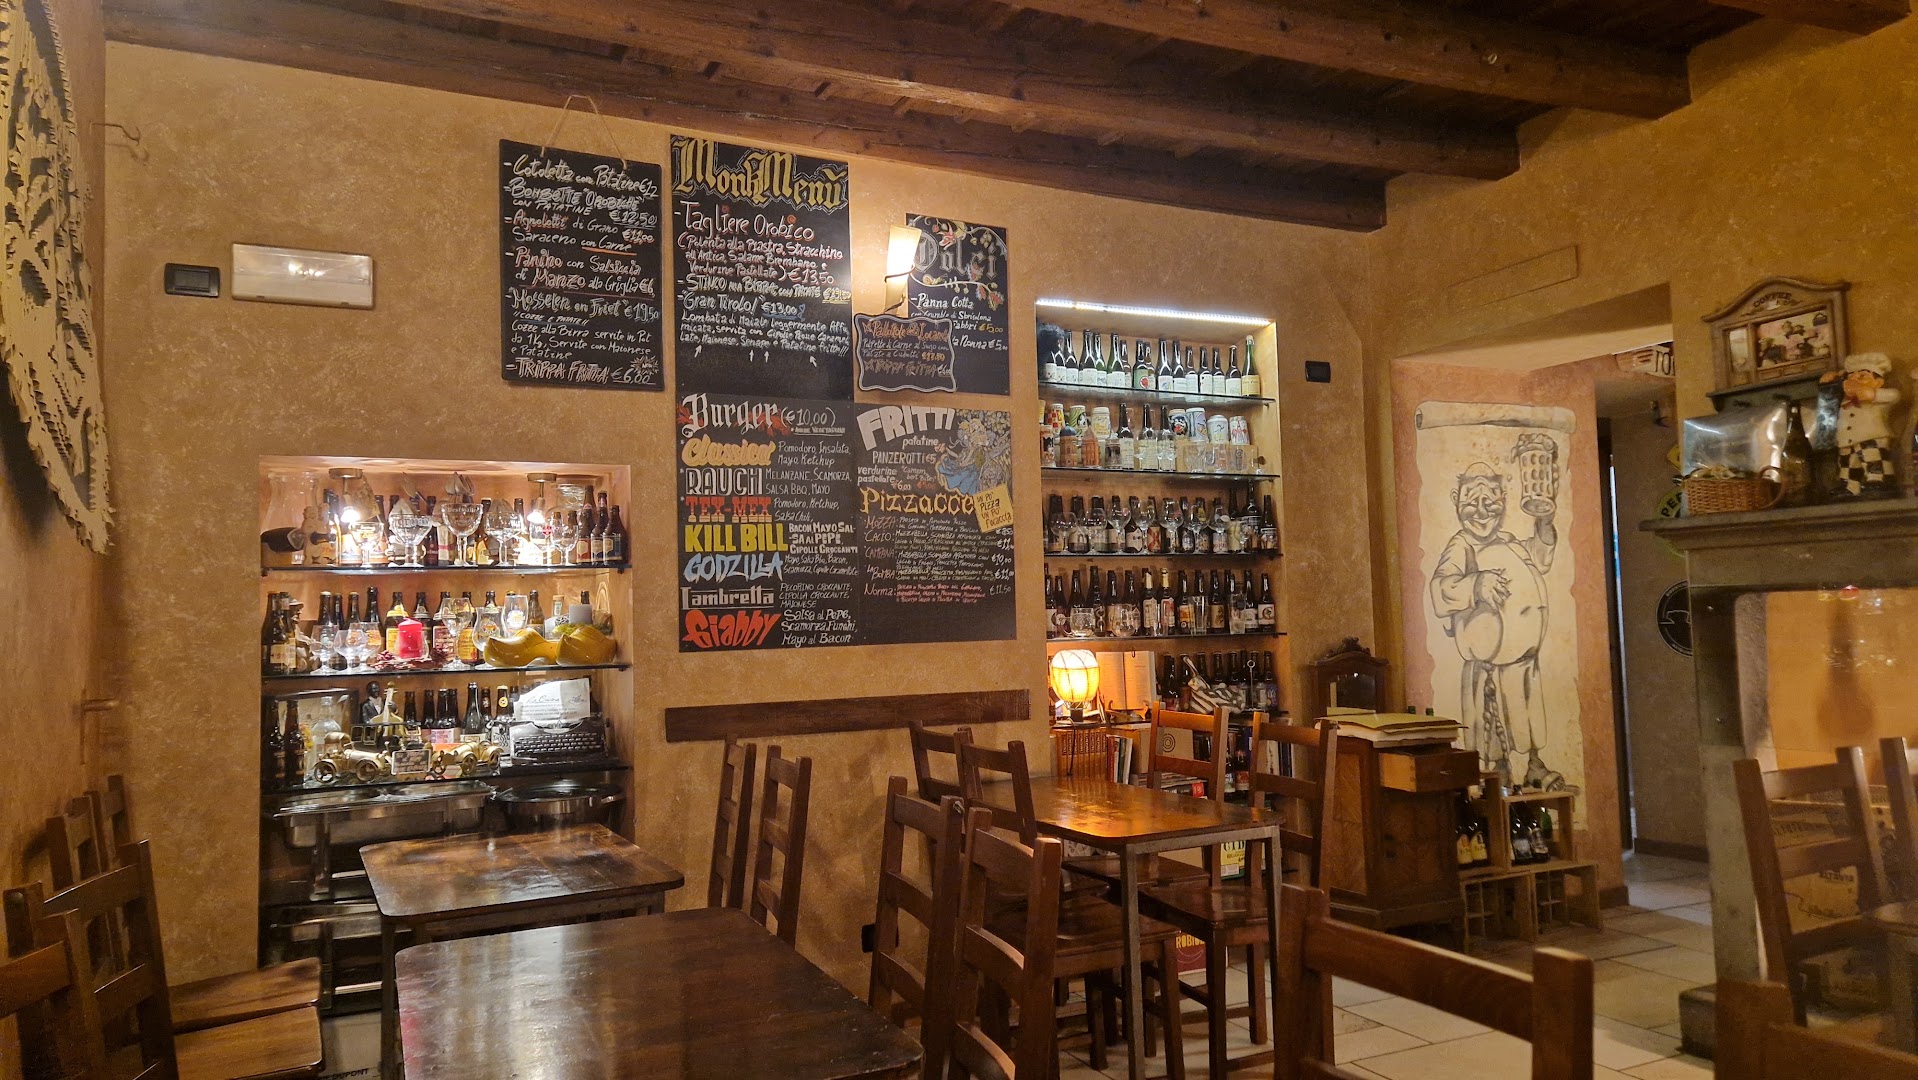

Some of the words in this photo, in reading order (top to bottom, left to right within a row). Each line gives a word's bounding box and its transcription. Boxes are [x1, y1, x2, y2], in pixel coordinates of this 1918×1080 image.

[513, 154, 574, 183] Cotoletta
[576, 175, 595, 185] con
[535, 200, 593, 215] PATATINE
[513, 209, 568, 231] Agnolotti
[573, 217, 584, 229] di
[588, 219, 618, 233] Grano
[680, 201, 750, 239] Tagliere
[754, 213, 815, 241] Orobico
[512, 226, 576, 245] Saraceno
[581, 239, 596, 247] con
[599, 235, 632, 251] Carne
[727, 236, 745, 250] alla
[786, 242, 843, 259] Stracchino
[515, 246, 562, 268] Panino
[567, 260, 585, 269] con
[590, 256, 642, 275] Salsiccia
[687, 260, 735, 276] Verdurine
[728, 250, 765, 262] Salame
[765, 251, 818, 269] Brembano
[516, 268, 528, 280] di
[532, 268, 586, 288] Manzo
[588, 277, 603, 289] alla
[605, 276, 640, 296] Griglia
[917, 292, 948, 308] Panna
[952, 296, 975, 309] Cotta
[681, 309, 727, 324] Lombata
[729, 313, 735, 324] di
[512, 320, 538, 331] Cozze
[541, 323, 557, 335] alla
[558, 325, 589, 338] Birra
[594, 330, 624, 340] servite
[627, 333, 636, 342] in
[637, 330, 651, 343] Pot
[512, 333, 523, 344] da
[549, 336, 588, 350] Servite
[608, 342, 651, 355] Maionese
[520, 345, 573, 360] Patatine
[682, 393, 778, 438] Burger
[781, 406, 836, 428] (€10,00)
[857, 405, 955, 451] FRITTI
[819, 441, 852, 455] Insalata,
[903, 435, 938, 449] patatine
[801, 453, 835, 468] Ketchup
[872, 451, 925, 465] PANZEROTTI
[857, 465, 897, 475] verdurine
[685, 467, 762, 495] RAUCH
[765, 484, 789, 495] SALSA
[811, 483, 830, 495] MAYO
[857, 475, 896, 487] pastellate
[685, 496, 772, 523] TEX-MEX
[860, 486, 975, 515] Pizzacce
[685, 523, 737, 552] KILL
[740, 522, 788, 552] BILL
[789, 544, 818, 554] CIPOLLE
[820, 544, 858, 554] CROCCANTI
[683, 552, 783, 584] GODZILLA
[779, 592, 808, 600] CIPOLLA
[780, 583, 814, 591] PECORINO
[680, 585, 774, 610] Lambretta
[780, 600, 817, 608] MAIONESE
[783, 609, 815, 621] Salsa
[817, 609, 824, 620] al
[781, 633, 807, 648] Mayo
[808, 634, 816, 644] al
[819, 632, 852, 644] Bacon
